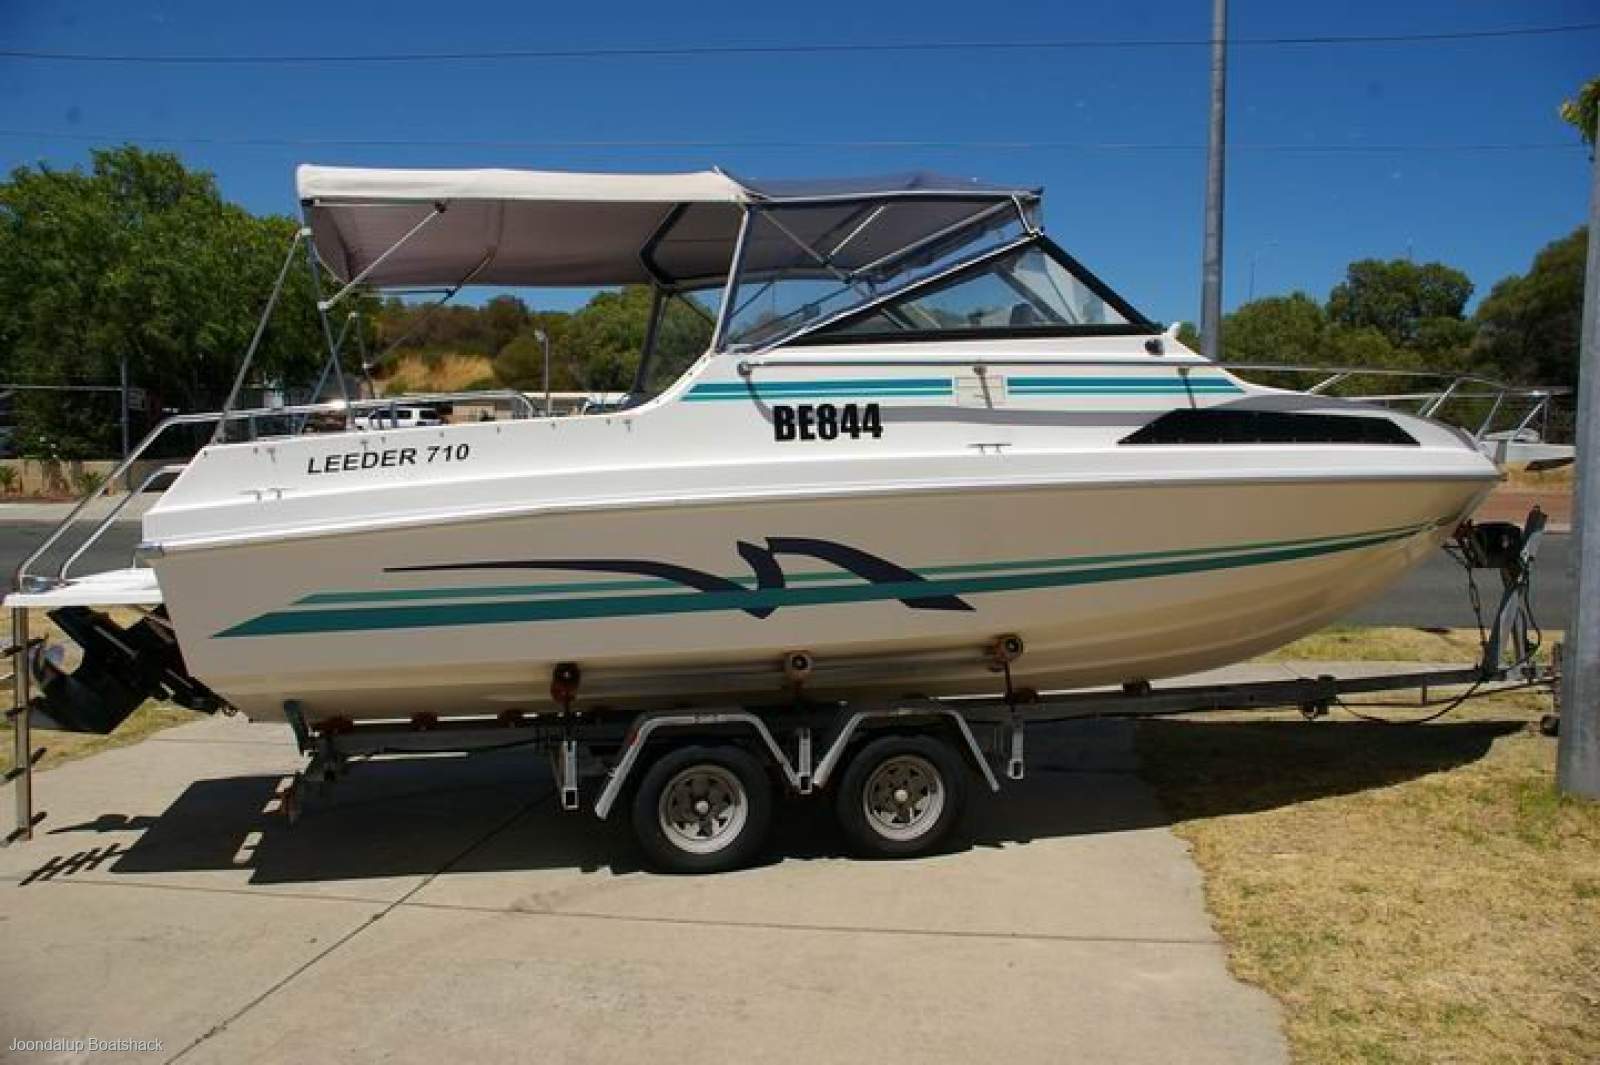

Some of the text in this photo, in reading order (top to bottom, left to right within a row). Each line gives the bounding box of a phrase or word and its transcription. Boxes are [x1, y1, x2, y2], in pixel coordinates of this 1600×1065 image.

[773, 403, 883, 442] BE844
[307, 443, 470, 474] LEEDER 710
